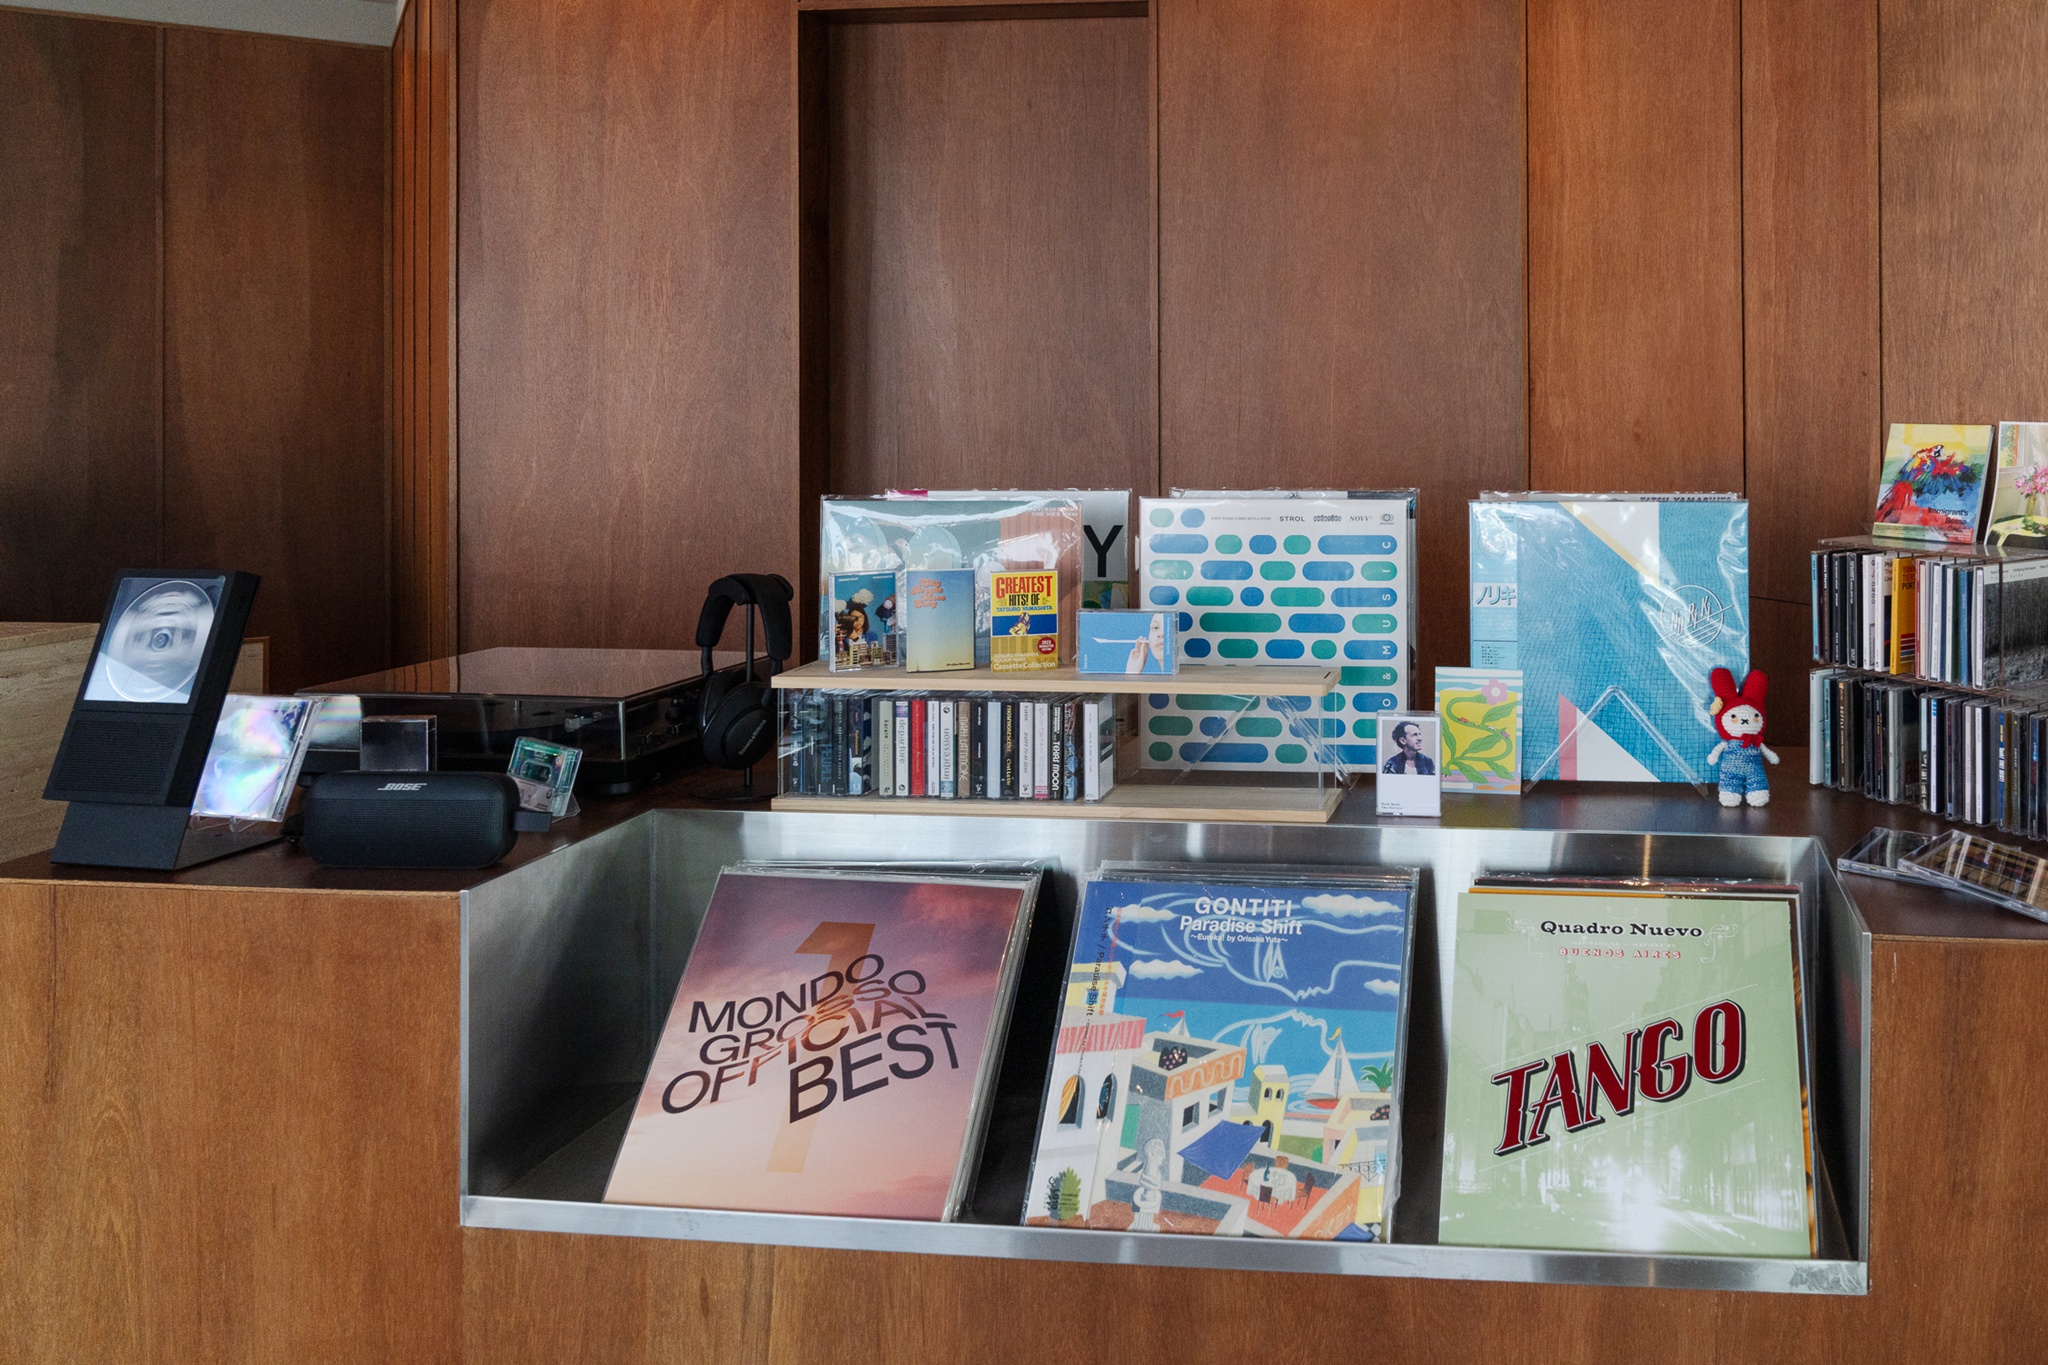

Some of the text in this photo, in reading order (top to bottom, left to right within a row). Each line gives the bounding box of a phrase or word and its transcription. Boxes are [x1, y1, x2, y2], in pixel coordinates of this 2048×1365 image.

[1928, 507, 1968, 516] Immigrant's
[996, 576, 1053, 599] GREATEST
[1477, 585, 1516, 606] ノリキ
[1008, 594, 1040, 606] HITS! OF
[377, 782, 428, 790] BOSE
[1052, 764, 1060, 790] MOON
[1195, 896, 1292, 917] GONTITI
[1180, 915, 1302, 935] Paradise Shift
[1540, 920, 1702, 938] Quadro Nuevo
[1226, 934, 1236, 942] by
[1559, 948, 1682, 960] BUENOS AIRES
[1091, 951, 1105, 990] Paradise
[688, 953, 885, 1034] MONDO
[1086, 991, 1097, 1016] Shift
[698, 970, 928, 1066] GROSSO
[660, 996, 949, 1115] OFFICIAL
[788, 1021, 960, 1124] BEST
[1491, 999, 1746, 1156] TANGO
